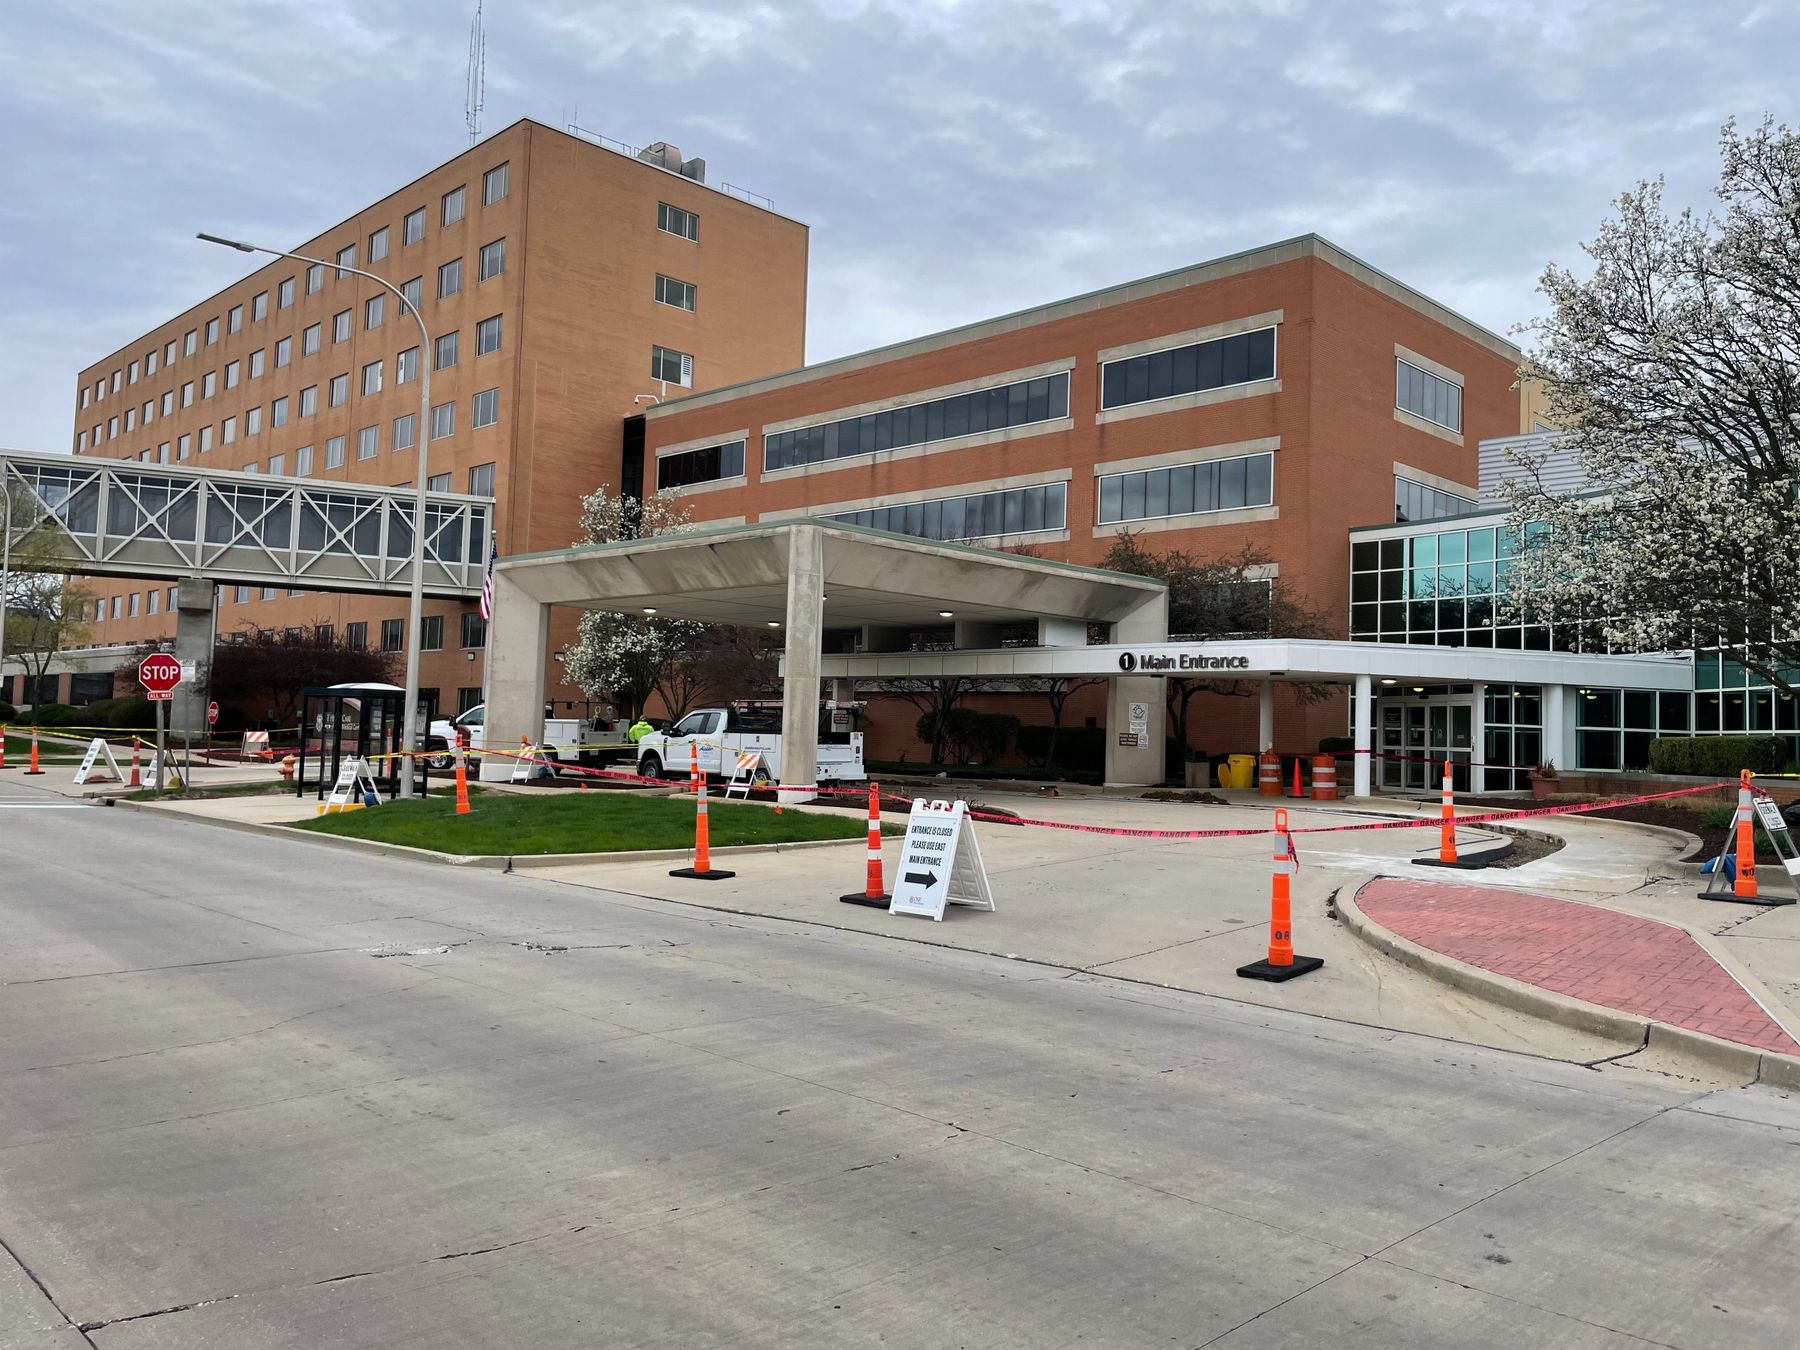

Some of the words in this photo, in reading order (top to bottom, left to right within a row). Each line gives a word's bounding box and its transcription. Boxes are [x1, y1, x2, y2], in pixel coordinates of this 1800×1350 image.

[1140, 654, 1176, 669] Main
[1179, 653, 1249, 669] Entrance
[143, 666, 179, 680] STOP
[209, 709, 218, 717] STOP
[1382, 821, 1413, 829] DANGER
[1420, 817, 1450, 826] DANGER
[1456, 815, 1485, 824] DANGER
[1491, 811, 1519, 820] DANGER
[1524, 808, 1551, 817] DANGER
[1556, 804, 1582, 814] DANGER
[911, 825, 932, 835] ENTRANCE
[937, 827, 953, 836] CLOSED
[1122, 829, 1153, 838] DANGER
[911, 840, 927, 850] PLEASE
[927, 841, 935, 850] USE
[935, 842, 946, 851] EAST
[909, 855, 920, 864] MAIN
[920, 856, 942, 867] ENTRANCE
